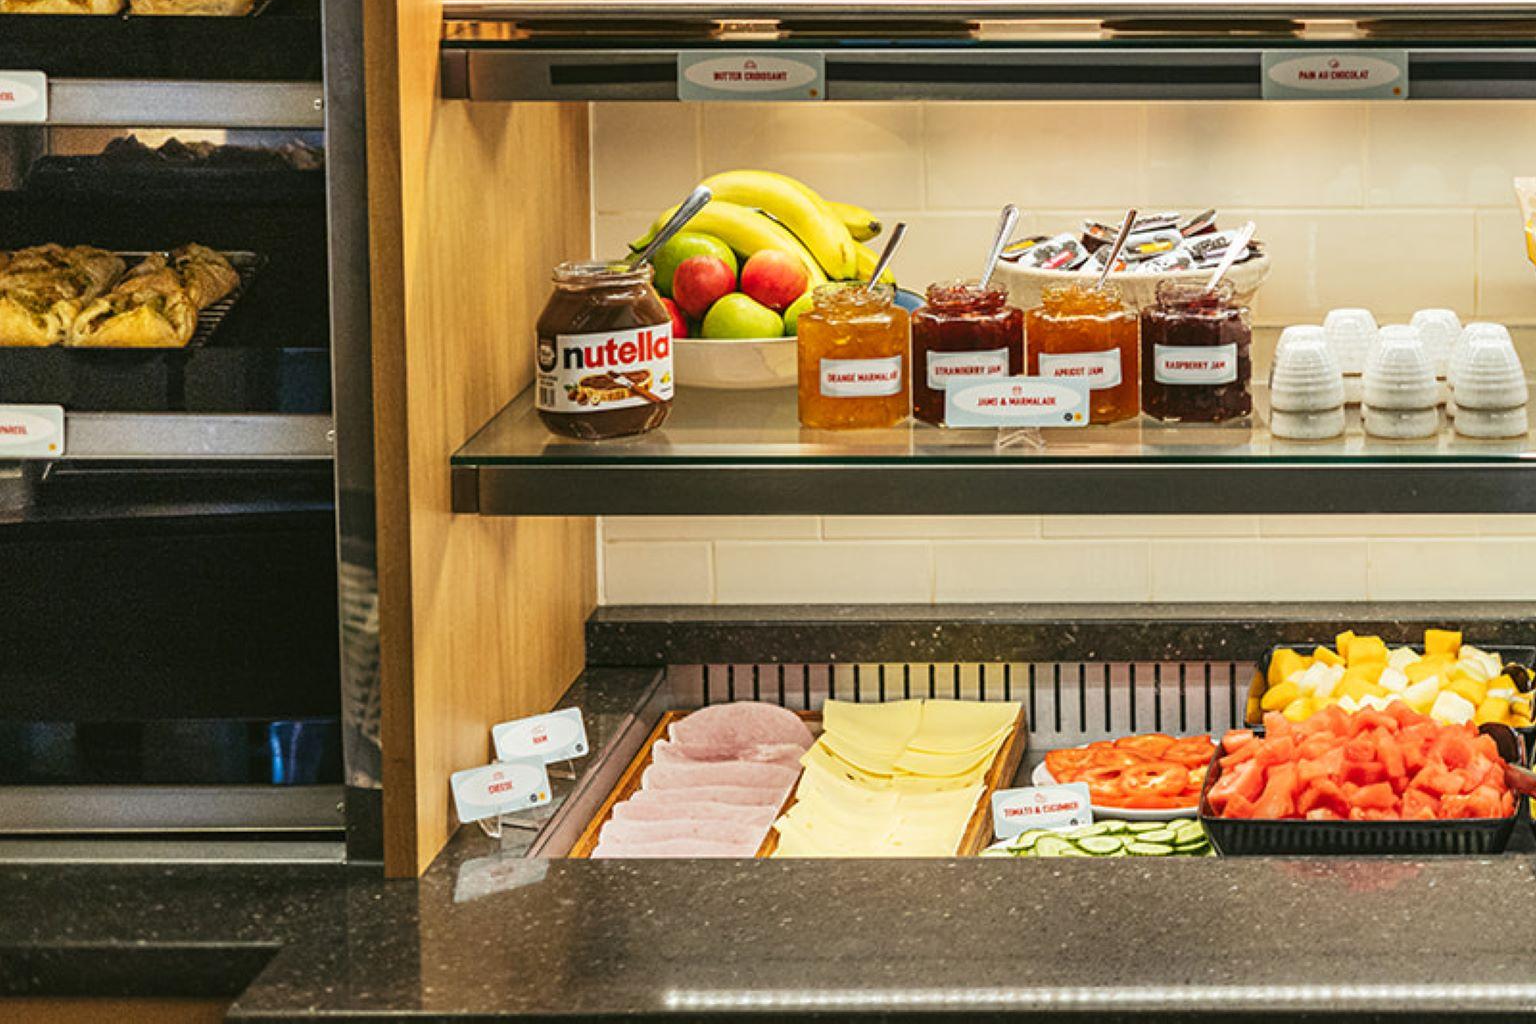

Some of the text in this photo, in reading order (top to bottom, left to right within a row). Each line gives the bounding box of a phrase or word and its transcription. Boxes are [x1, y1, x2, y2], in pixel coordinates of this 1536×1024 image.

[713, 71, 787, 81] BUTTER CROISSANT
[1299, 70, 1316, 80] PAIN
[1331, 69, 1369, 80] CHOCOLAT
[563, 330, 669, 370] nutella
[935, 365, 985, 376] STRAWBERRY
[1164, 360, 1226, 370] RASPBERRY JAM
[1054, 366, 1104, 377] APRICOT JAM
[827, 372, 854, 383] ORANGE
[977, 397, 998, 407] JAMS
[1008, 396, 1057, 406] MARMALADE
